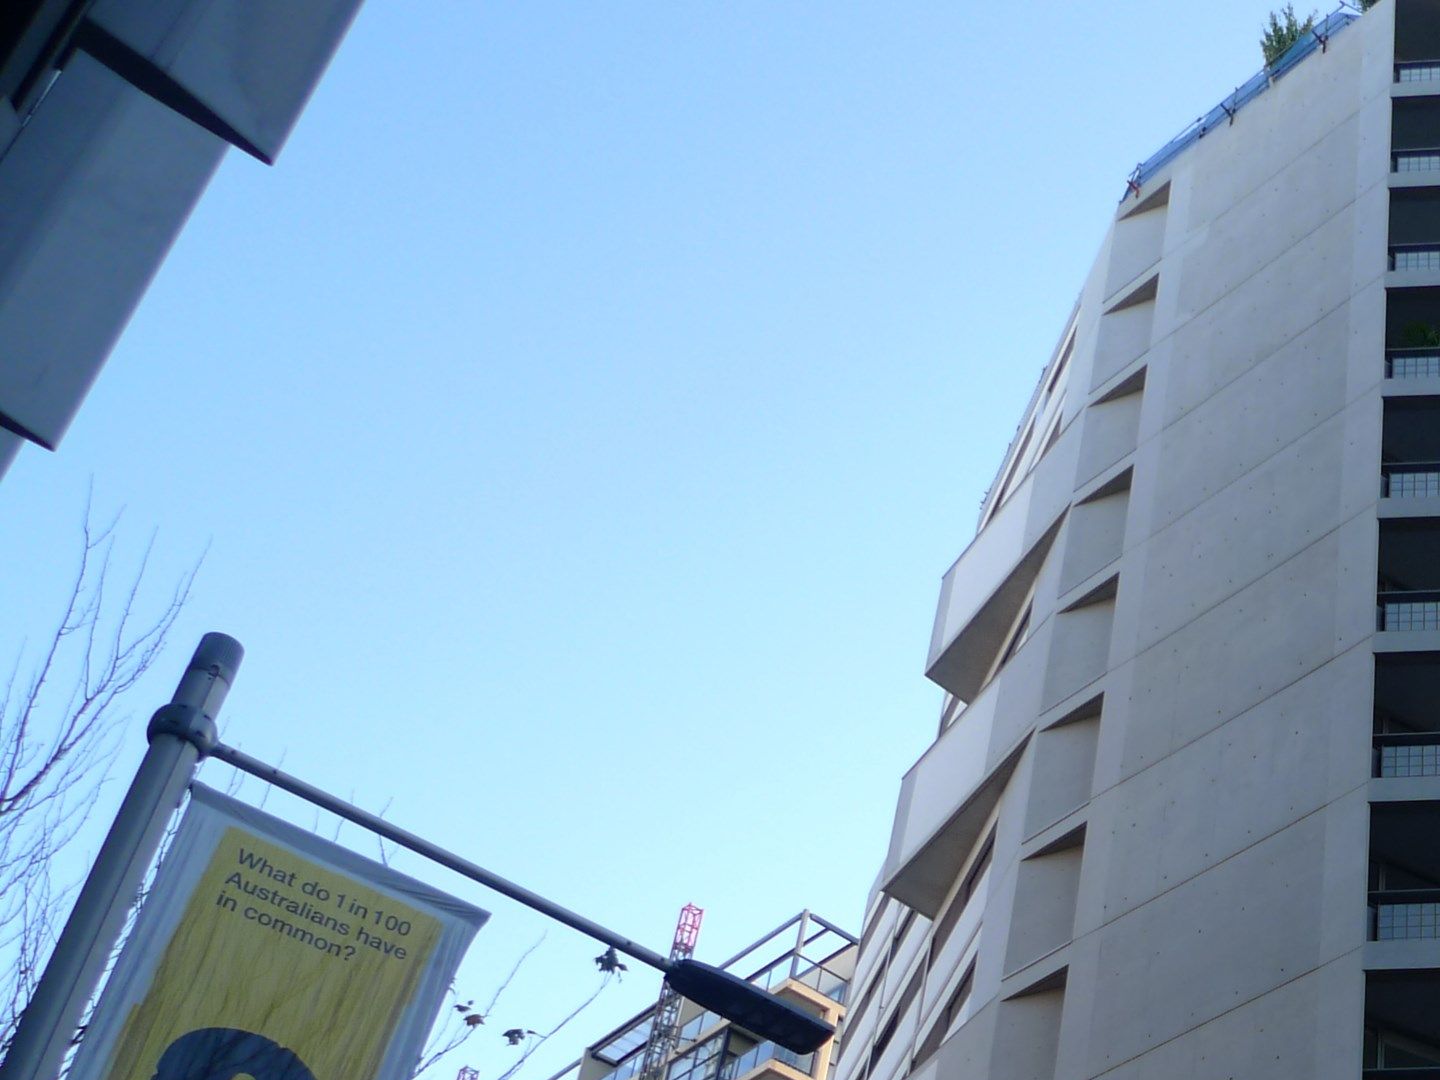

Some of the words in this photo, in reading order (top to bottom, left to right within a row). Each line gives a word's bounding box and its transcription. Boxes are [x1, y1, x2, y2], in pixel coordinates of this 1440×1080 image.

[216, 891, 238, 911] in
[244, 906, 357, 961] common?
[225, 872, 350, 936] Australians
[356, 926, 407, 960] have
[238, 848, 297, 887] What
[302, 880, 330, 901] do
[337, 894, 346, 908] 1
[350, 899, 368, 920] in
[374, 911, 411, 936] 100
